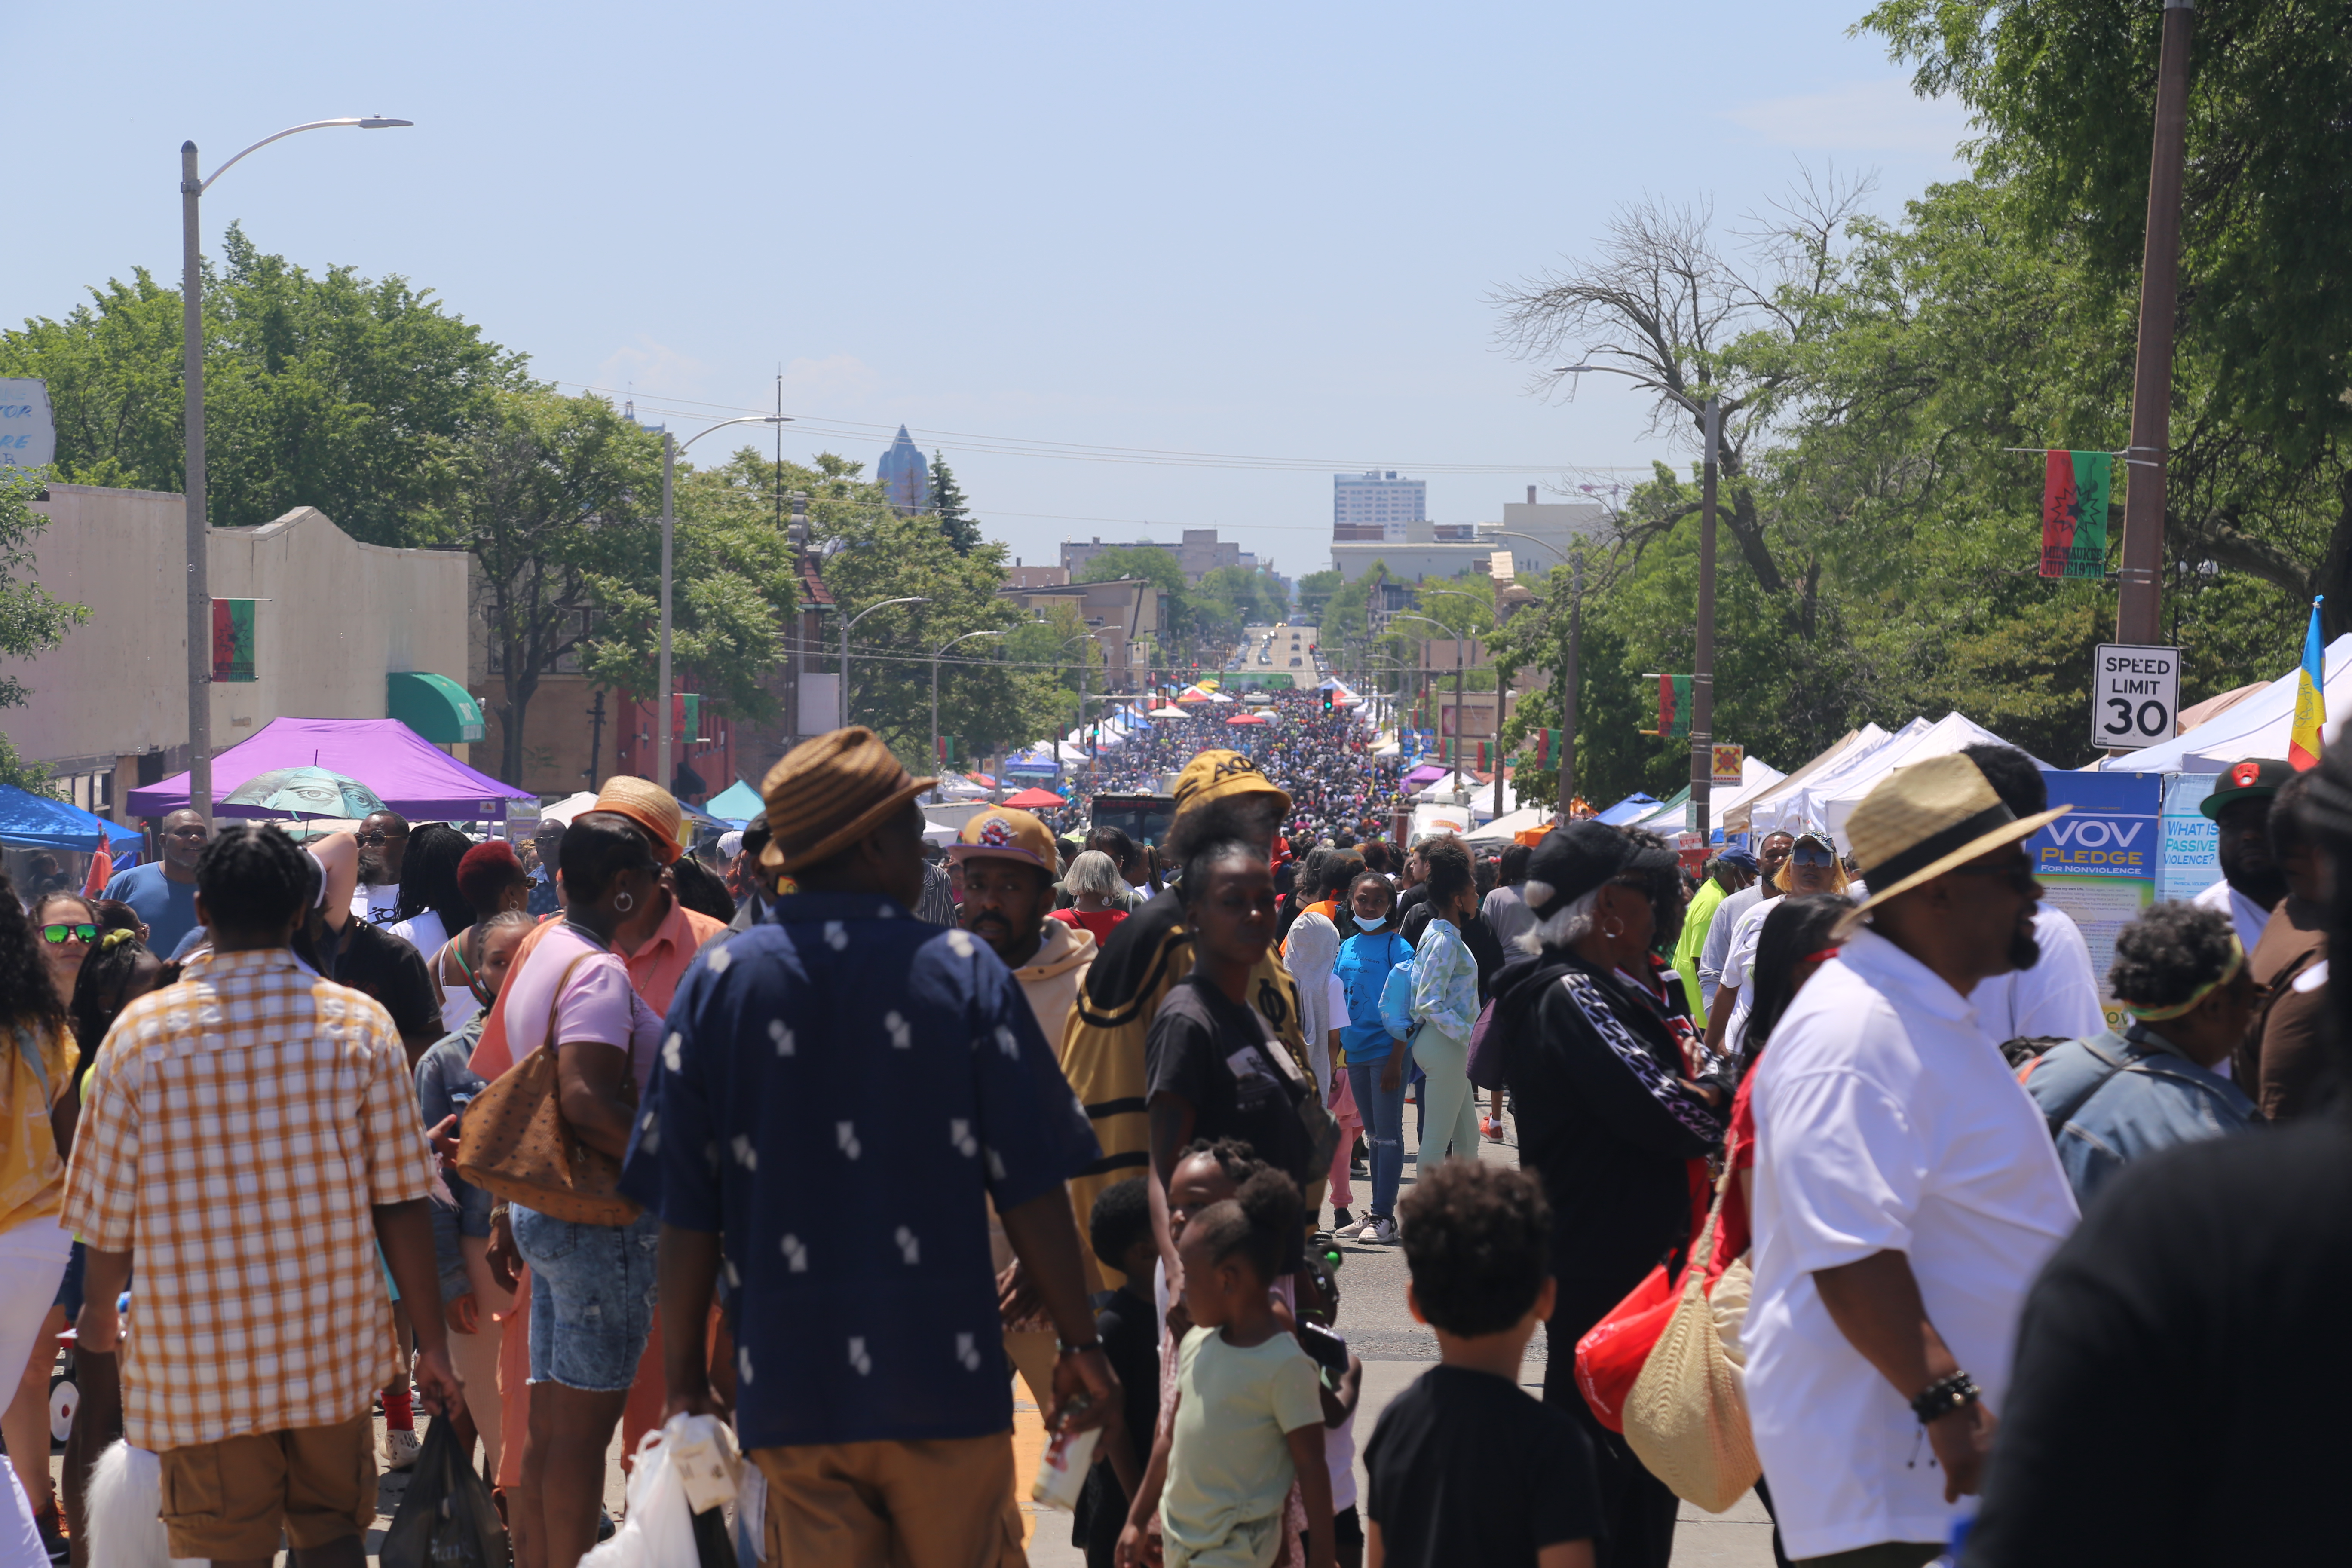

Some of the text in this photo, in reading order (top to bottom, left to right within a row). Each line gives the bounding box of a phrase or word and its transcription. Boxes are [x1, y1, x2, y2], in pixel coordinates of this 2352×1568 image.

[2044, 546, 2102, 560] MILWAUKEE
[2105, 657, 2170, 674] SPEED
[2112, 679, 2160, 695] LIMIT
[2104, 698, 2168, 737] 30
[2046, 821, 2143, 847] VOV
[2168, 821, 2220, 836] WHAT IS
[2165, 838, 2217, 852] PASSIVE
[2041, 847, 2143, 865] PLEDGE
[2164, 854, 2215, 864] VIOLENCE?
[2065, 865, 2141, 874] NONVIOLENCE
